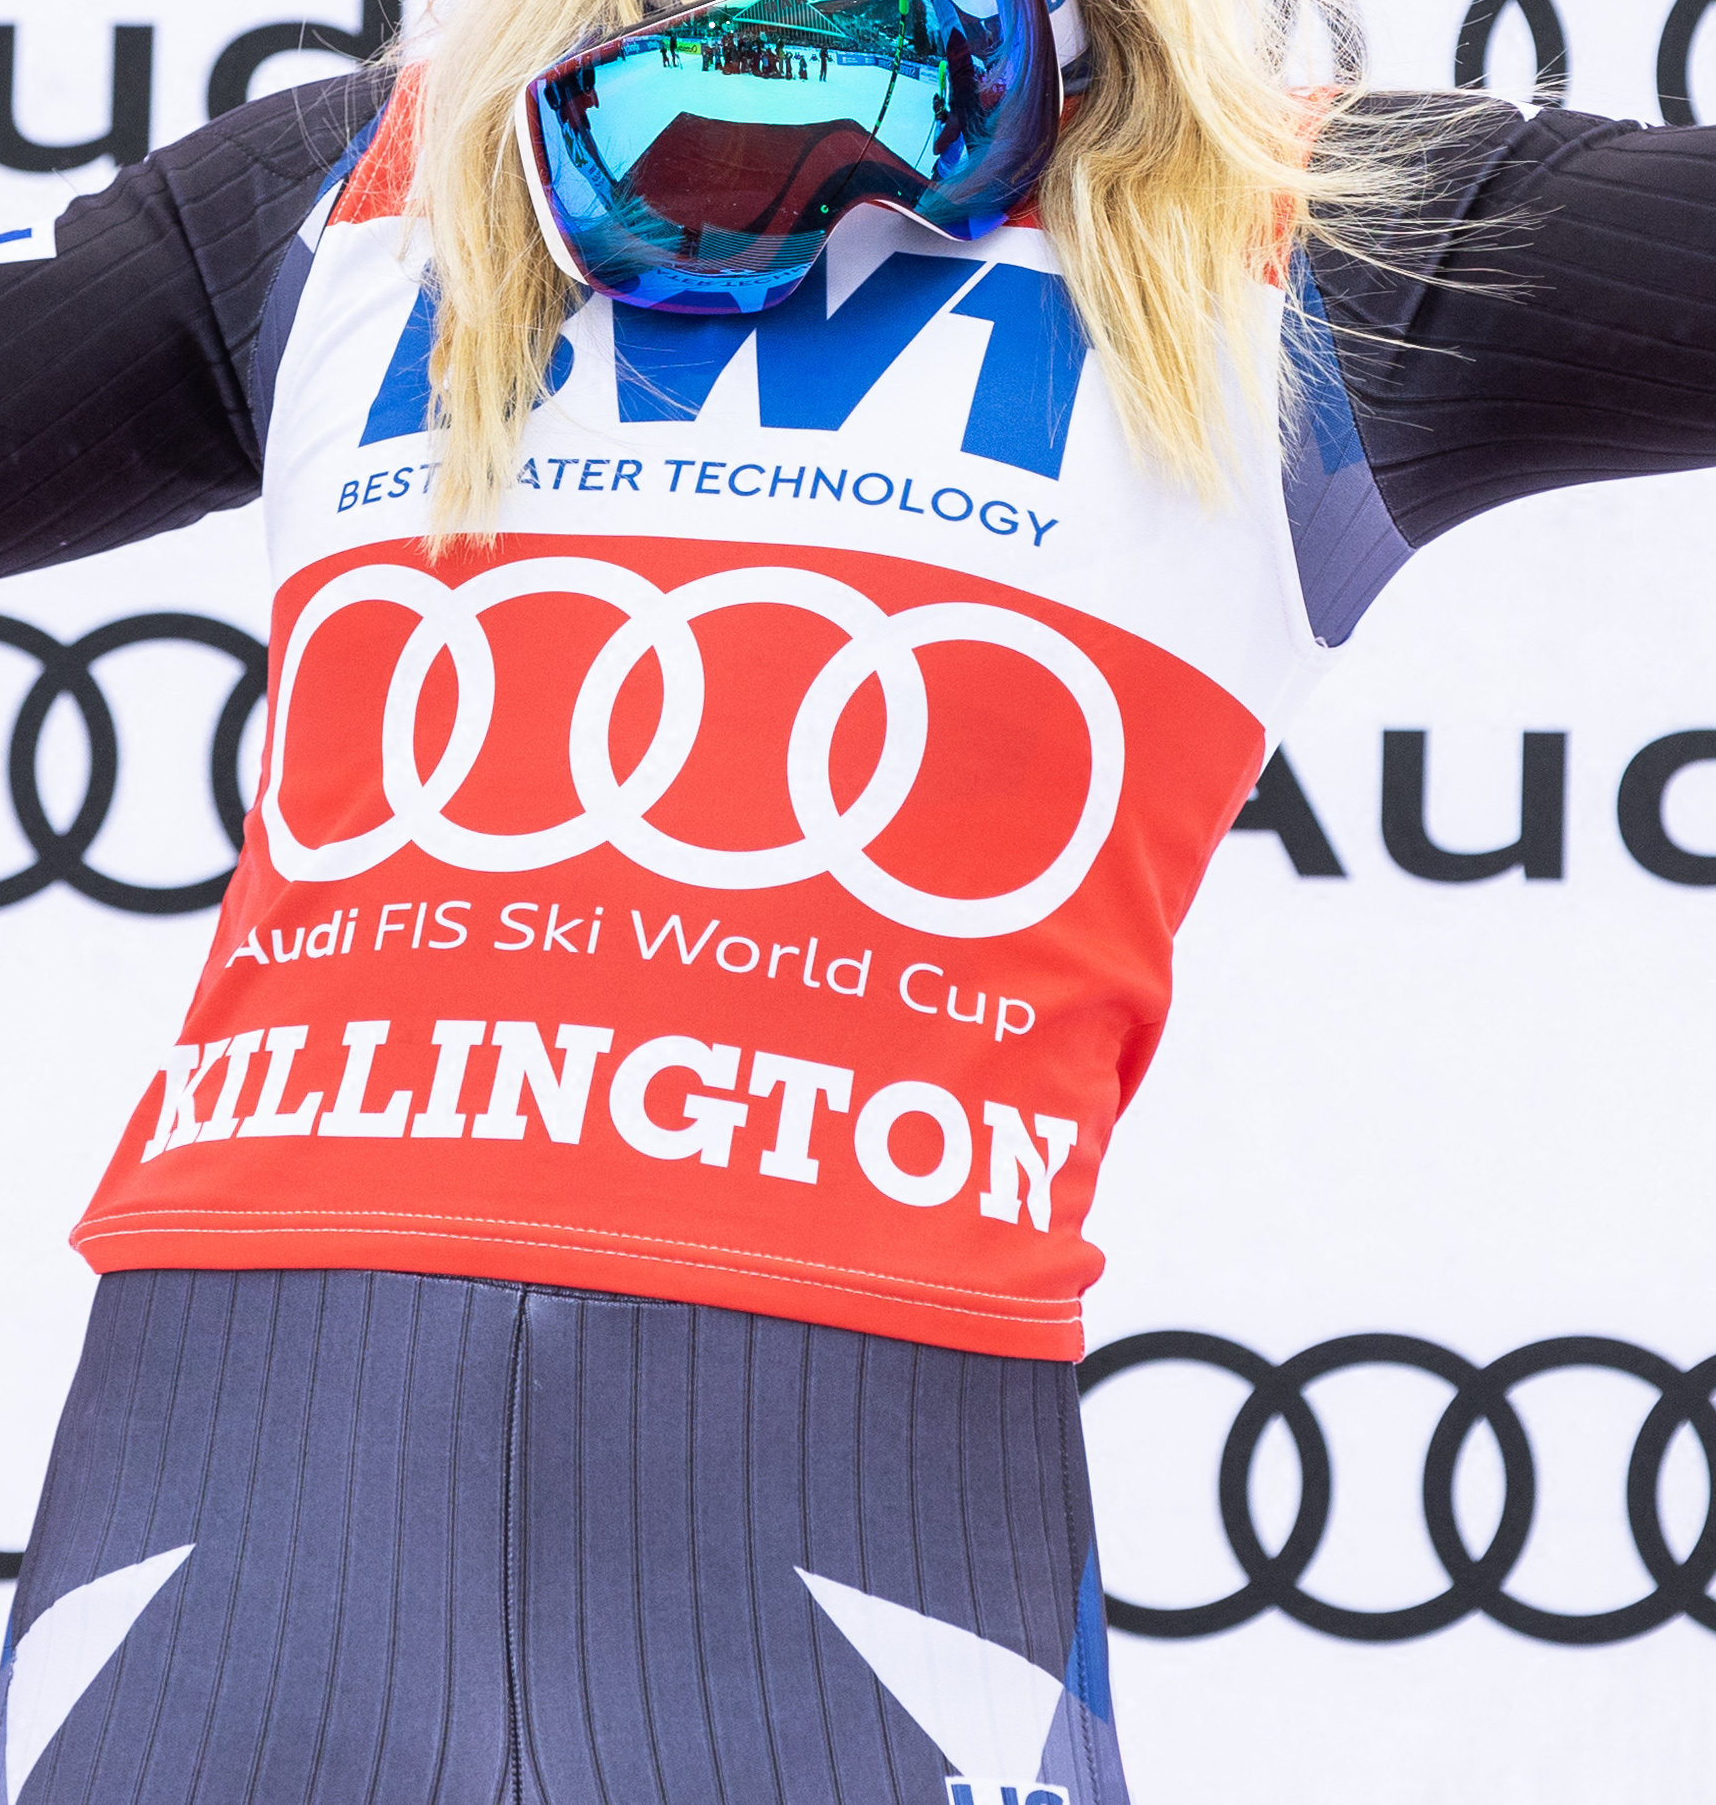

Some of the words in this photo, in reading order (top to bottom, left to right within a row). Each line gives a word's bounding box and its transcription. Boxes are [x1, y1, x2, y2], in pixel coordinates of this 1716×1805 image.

[337, 462, 442, 514] BEST
[490, 457, 643, 493] ATER
[664, 459, 1060, 547] TECHNOLOGY
[225, 907, 359, 969] Audi
[374, 900, 473, 951] FIS
[493, 901, 604, 955] Ski
[631, 909, 873, 998] World
[898, 962, 1037, 1043] Cup
[140, 1019, 1080, 1234] KILLINGTON
